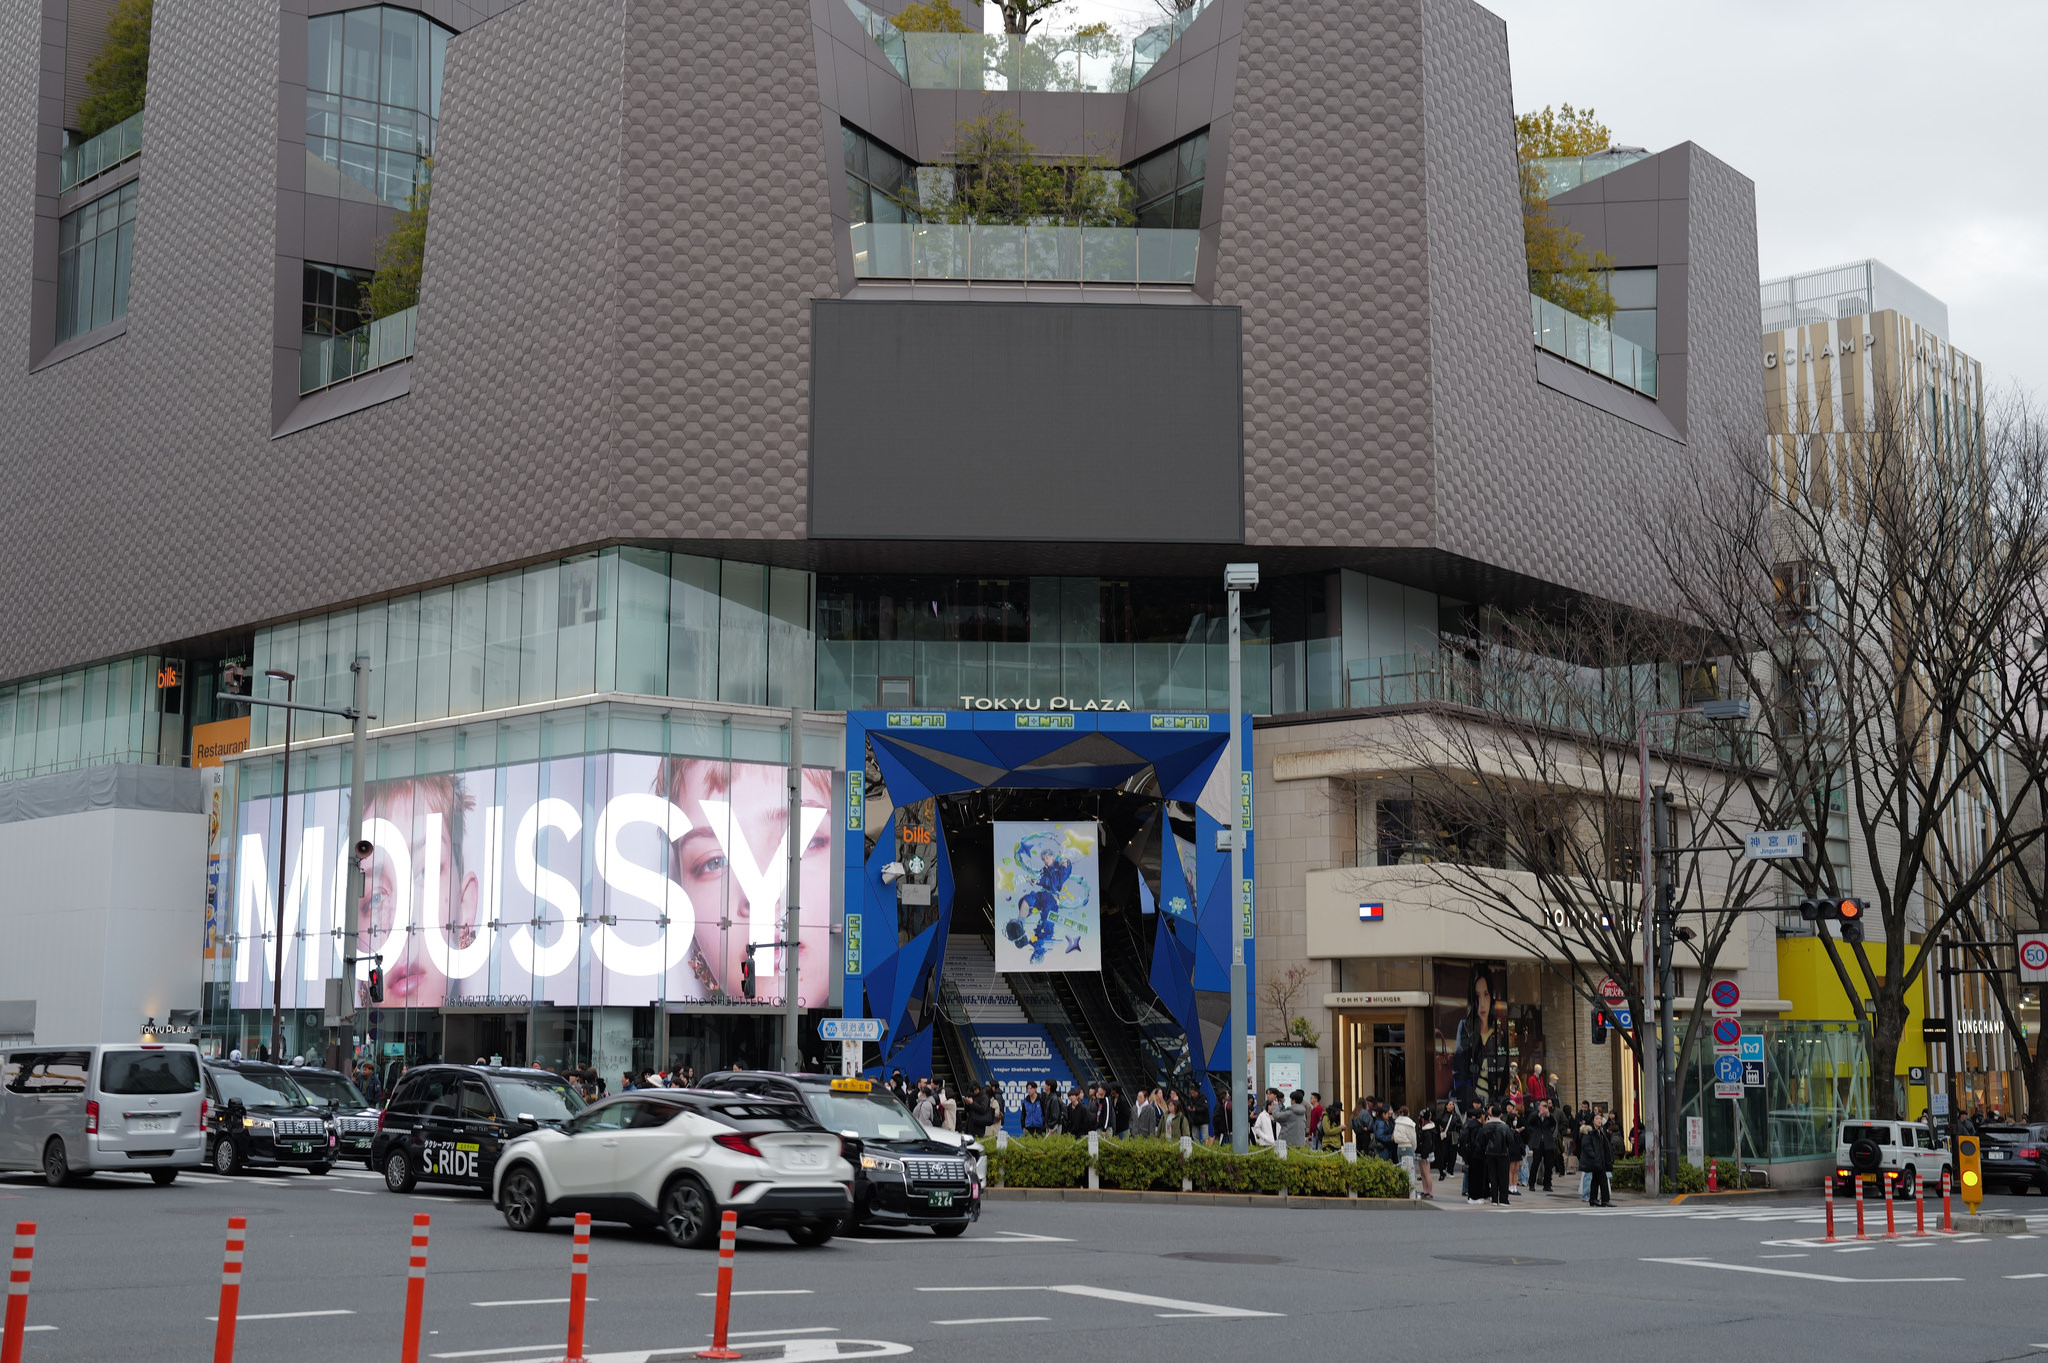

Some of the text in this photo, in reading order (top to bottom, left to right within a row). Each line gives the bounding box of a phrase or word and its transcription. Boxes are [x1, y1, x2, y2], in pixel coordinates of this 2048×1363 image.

[157, 666, 176, 688] bills
[960, 696, 1131, 711] TOKYU PLAZA
[197, 738, 247, 759] Restaurant
[903, 825, 931, 844] bills
[1750, 834, 1798, 848] 神宮前
[235, 793, 828, 984] MOUSSY
[2026, 949, 2045, 962] 50
[499, 994, 528, 1007] TOKYO
[684, 994, 707, 1006] The
[768, 996, 806, 1008] TOKO
[997, 994, 1017, 1005] 2026
[141, 1024, 191, 1034] TOKYU PLAZA
[827, 1025, 837, 1033] 305
[841, 1022, 874, 1033] 明治通り
[1957, 1020, 2005, 1034] LONGCHAMP
[1721, 1062, 1732, 1079] P
[1728, 1072, 1737, 1080] 60
[424, 1140, 455, 1149] タクシーアプリ
[423, 1148, 479, 1178] S.RIDE
